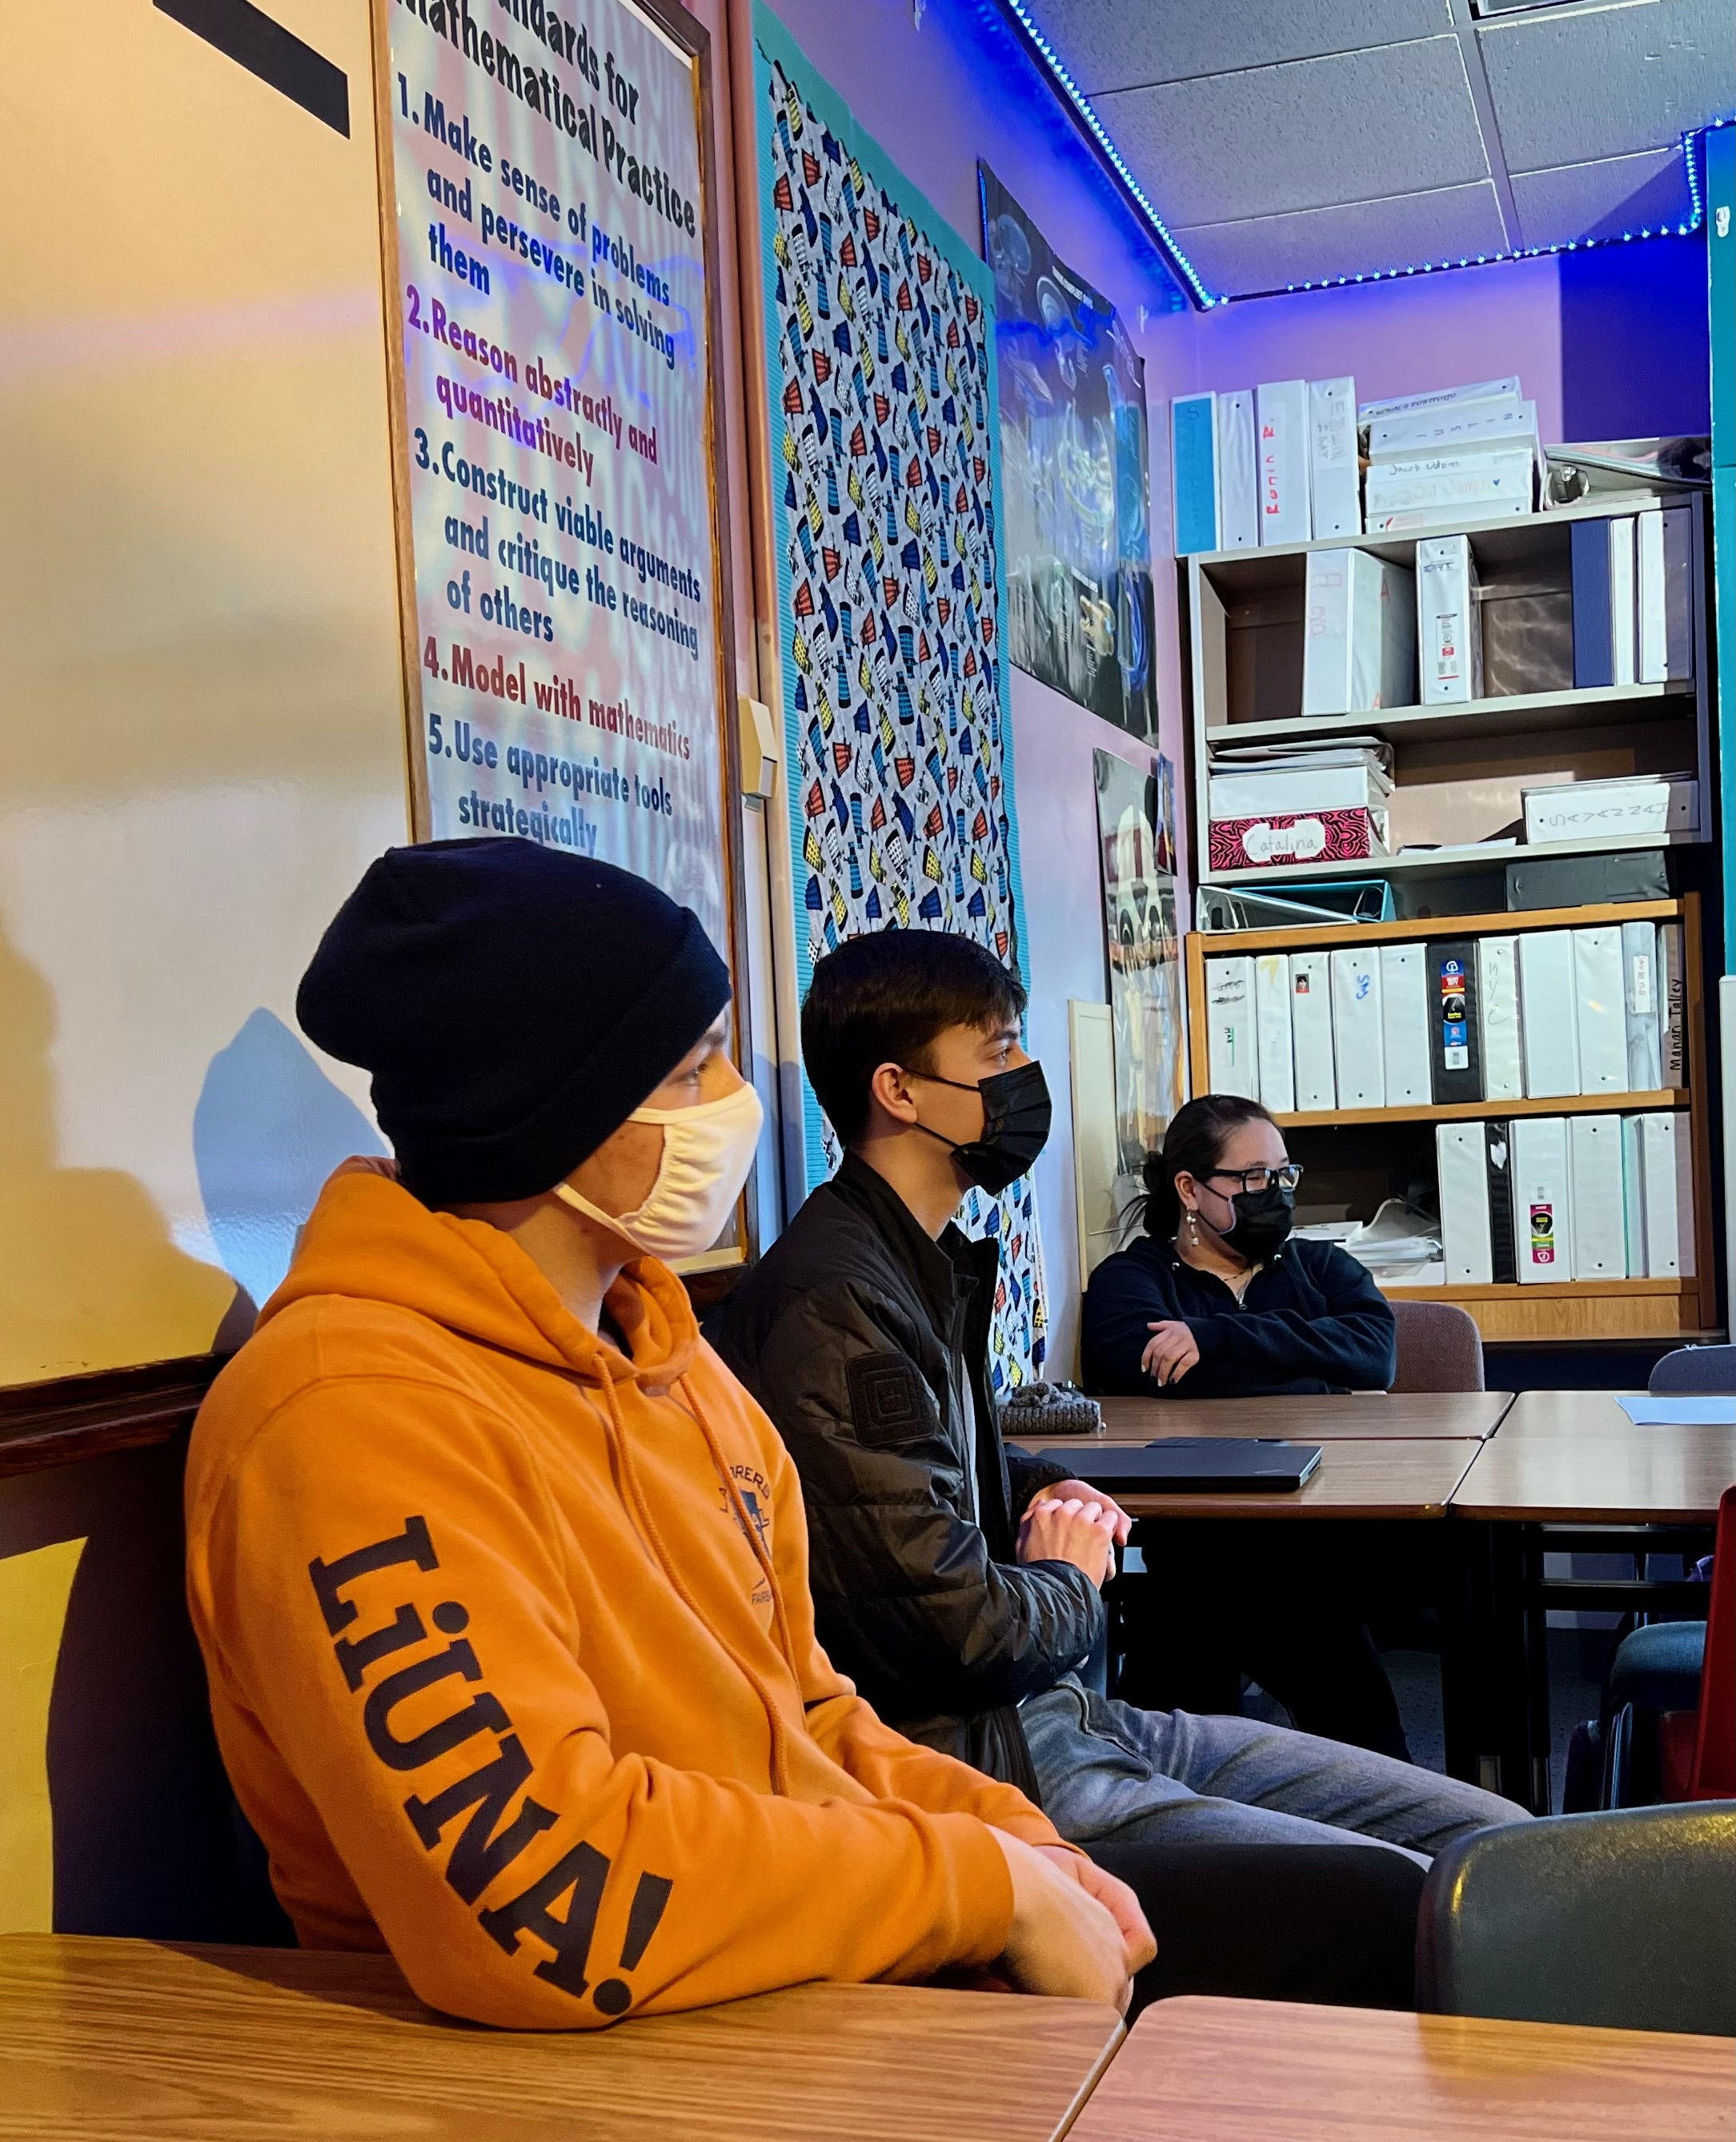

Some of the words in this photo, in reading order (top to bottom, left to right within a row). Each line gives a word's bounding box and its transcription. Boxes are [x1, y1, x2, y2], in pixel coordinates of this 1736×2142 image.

[604, 51, 639, 125] for
[601, 115, 696, 239] Practice
[427, 168, 472, 223] and
[481, 203, 584, 296] persevere
[591, 268, 611, 315] in
[615, 297, 675, 370] solving
[428, 223, 490, 295] them
[501, 158, 560, 223] sense
[567, 202, 586, 243] of
[591, 222, 669, 307] problems
[436, 375, 594, 487] quantitatively
[525, 355, 623, 451] abstractly
[628, 426, 658, 465] and
[444, 514, 488, 560] and
[498, 531, 579, 597] critique
[586, 564, 616, 612] the
[622, 592, 699, 661] reasoning
[555, 495, 614, 555] viable
[619, 535, 701, 603] arguments
[447, 570, 471, 610] of
[479, 587, 554, 643] others
[533, 674, 582, 722] with
[588, 698, 691, 760] mathematics
[459, 789, 597, 856] strategically
[507, 744, 629, 803] appropriate
[634, 773, 672, 816] tools
[1245, 832, 1319, 856] Catalina
[307, 1514, 674, 2016] LiUNA!
